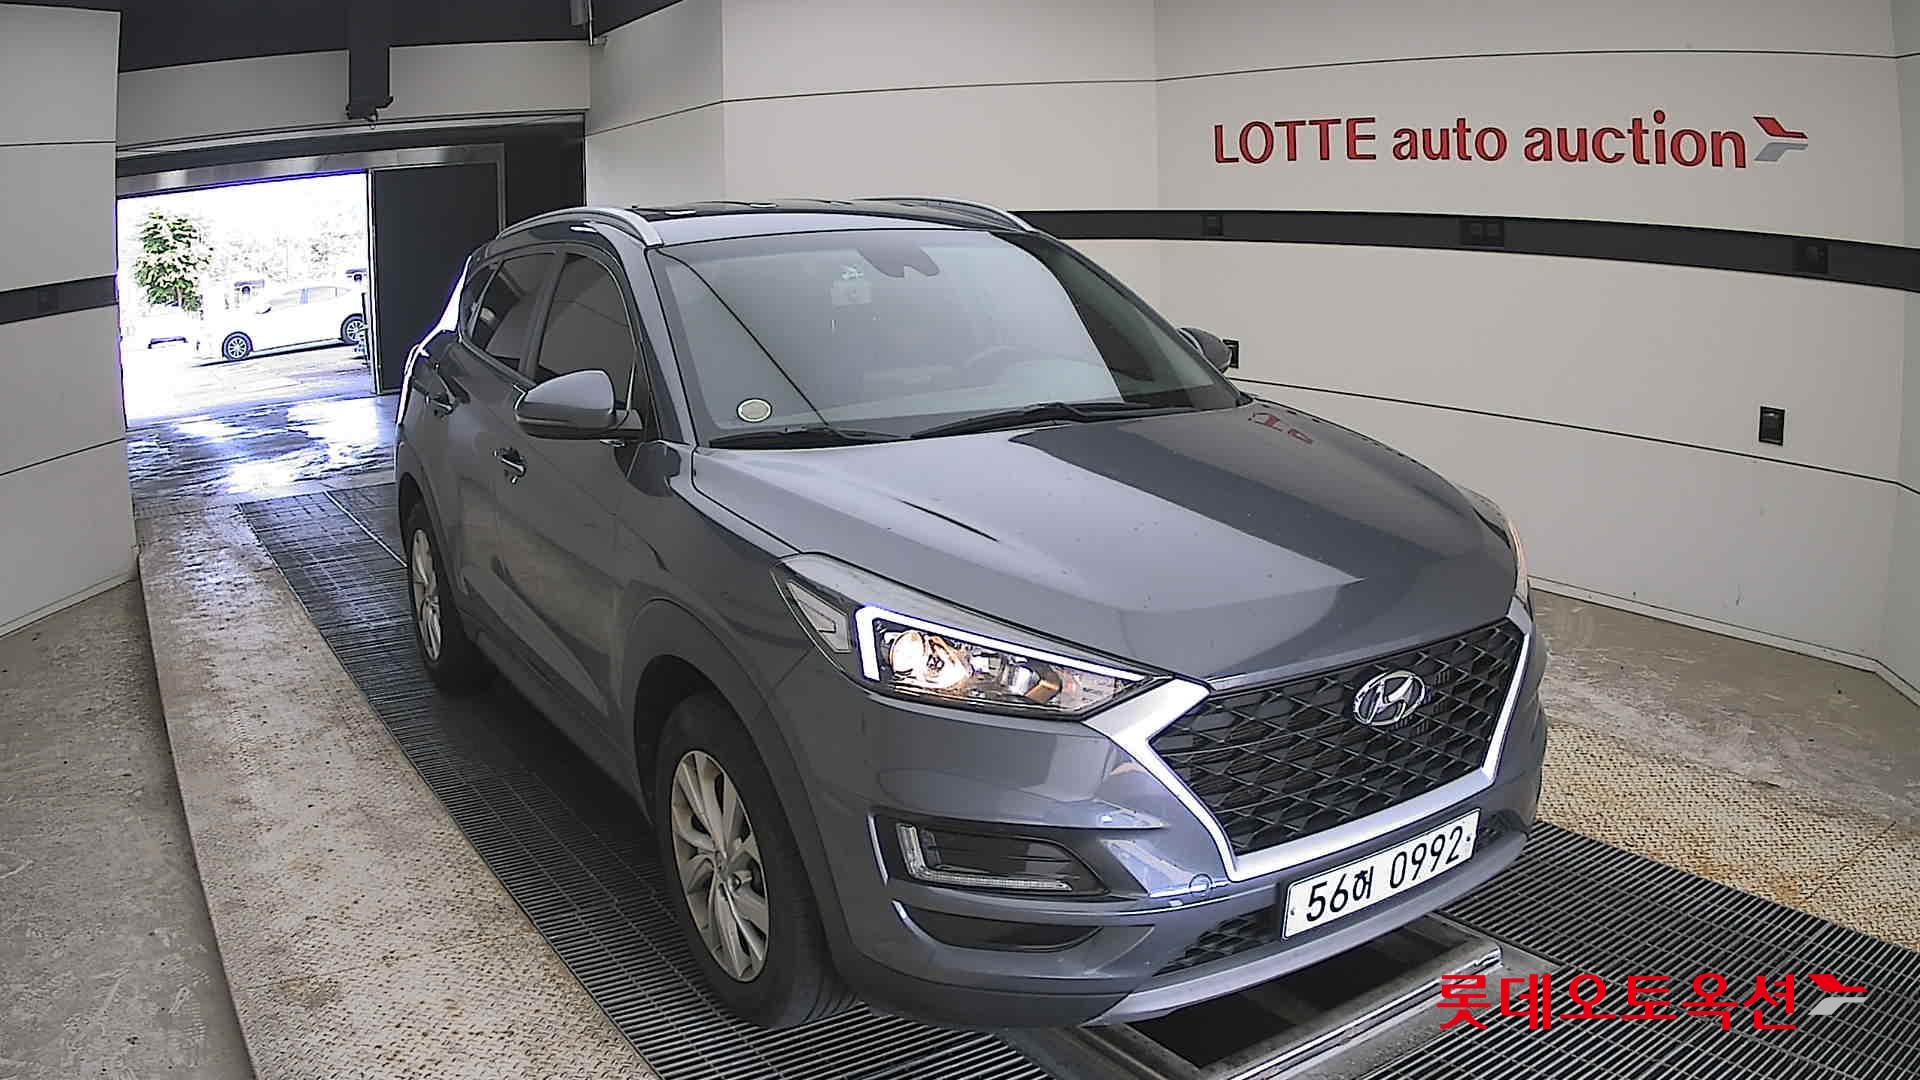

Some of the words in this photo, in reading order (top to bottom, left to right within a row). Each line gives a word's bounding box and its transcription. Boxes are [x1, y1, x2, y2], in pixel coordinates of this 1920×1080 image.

[1213, 116, 1377, 164] LOTTE
[1392, 117, 1508, 161] auto
[1523, 110, 1747, 169] auction
[1306, 866, 1375, 922] 56허
[1389, 825, 1463, 889] 0992
